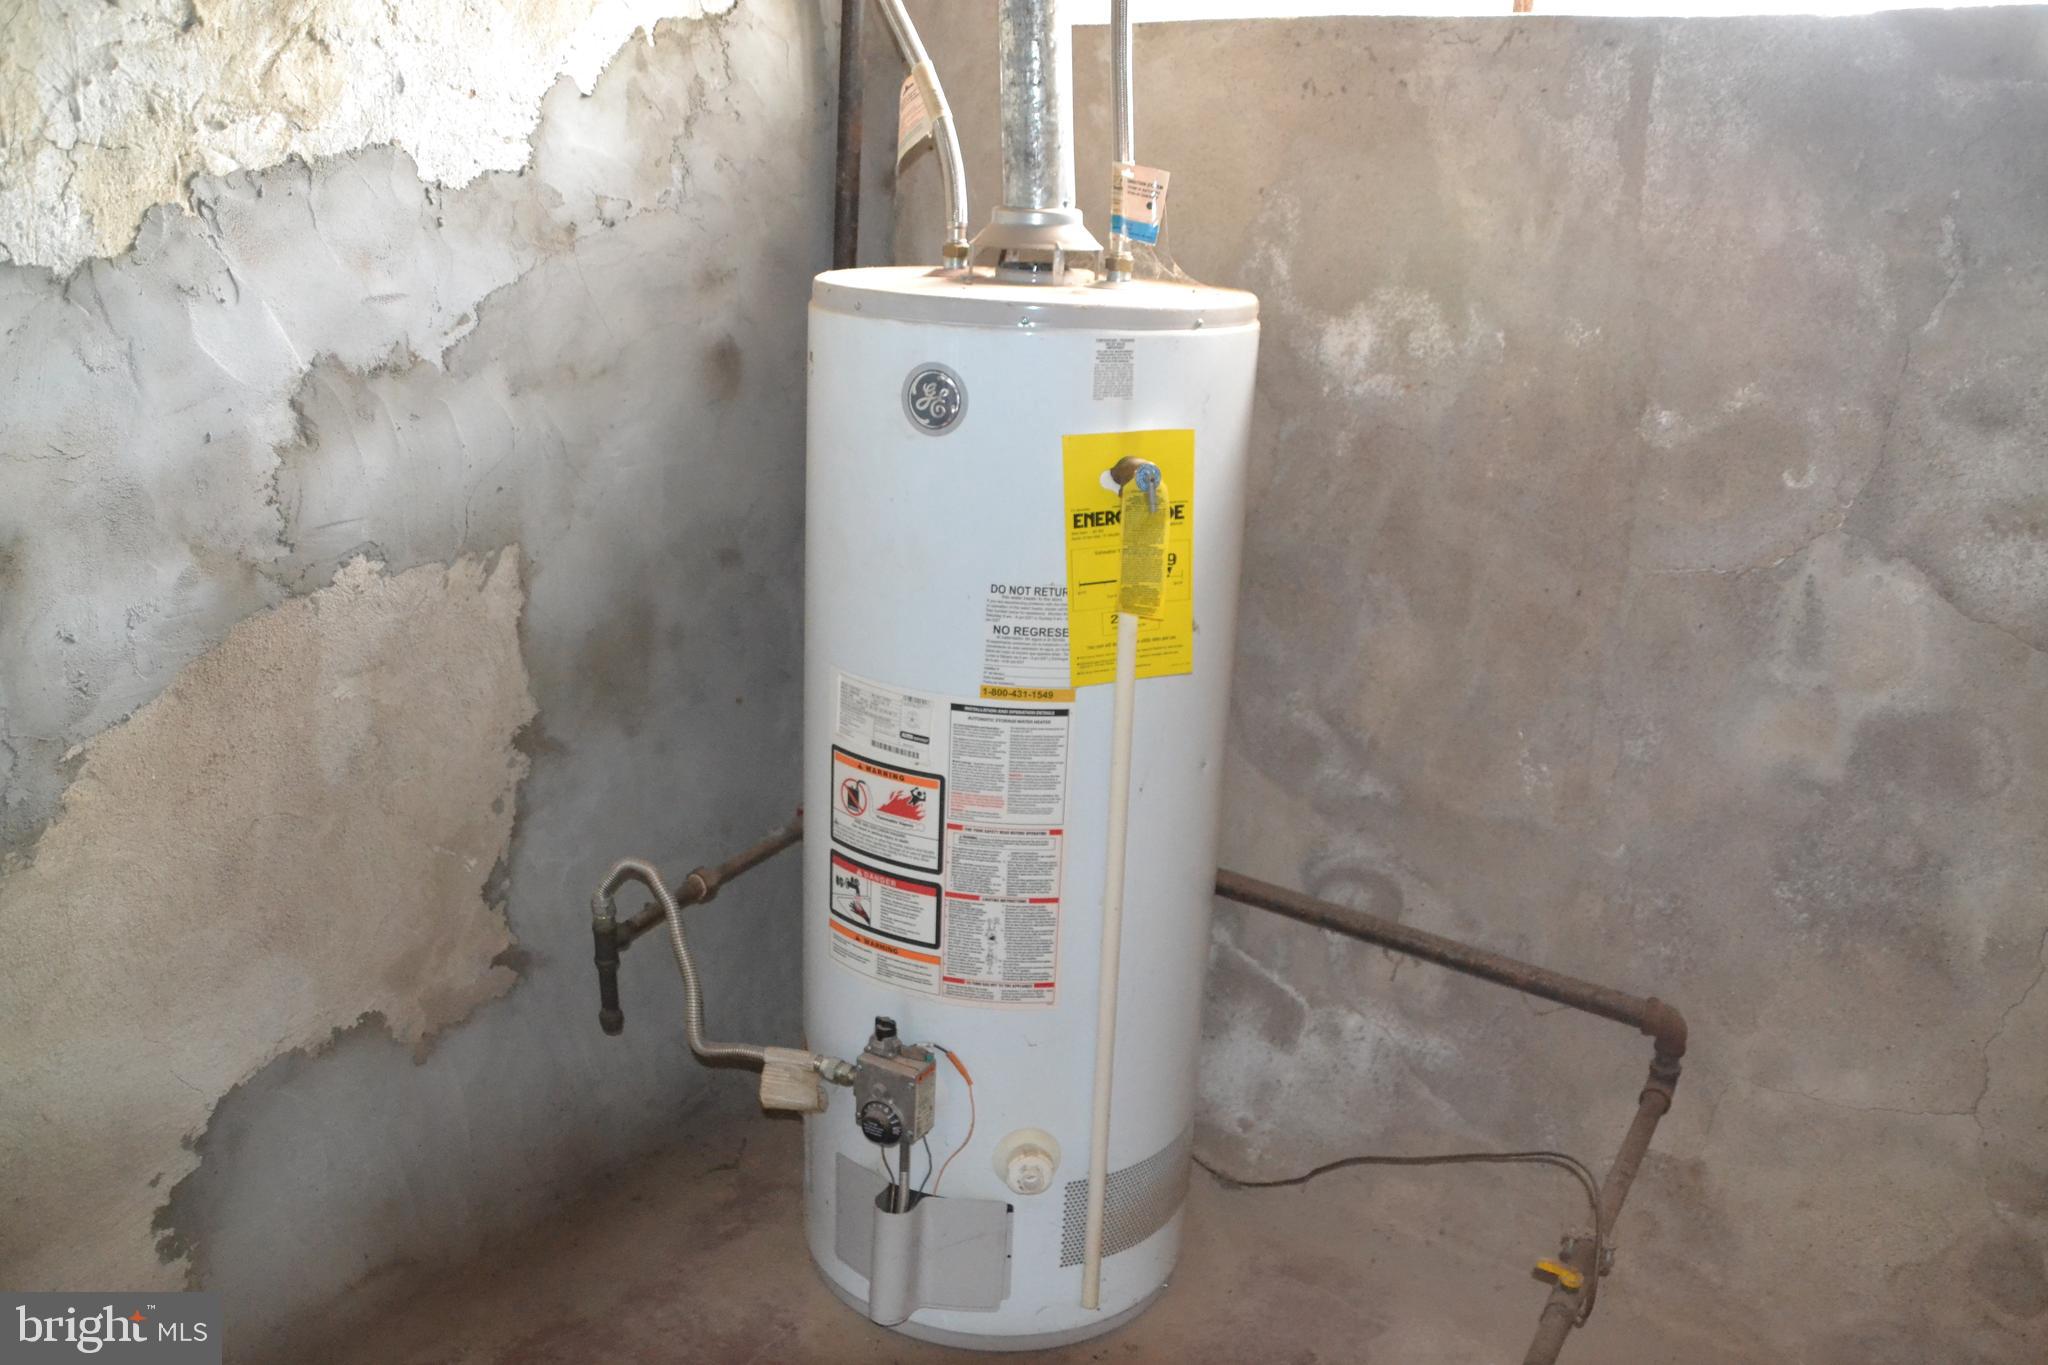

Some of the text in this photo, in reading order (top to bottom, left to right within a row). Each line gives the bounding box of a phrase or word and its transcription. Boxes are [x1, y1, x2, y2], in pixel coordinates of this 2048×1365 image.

[990, 584, 1006, 594] DO
[1009, 586, 1031, 596] NOT
[993, 625, 1069, 637] NO REGRESE
[983, 688, 1054, 699] 1-800-431-1549
[866, 765, 905, 781] WARNING
[863, 869, 897, 888] DANGER
[864, 938, 898, 954] WARNING
